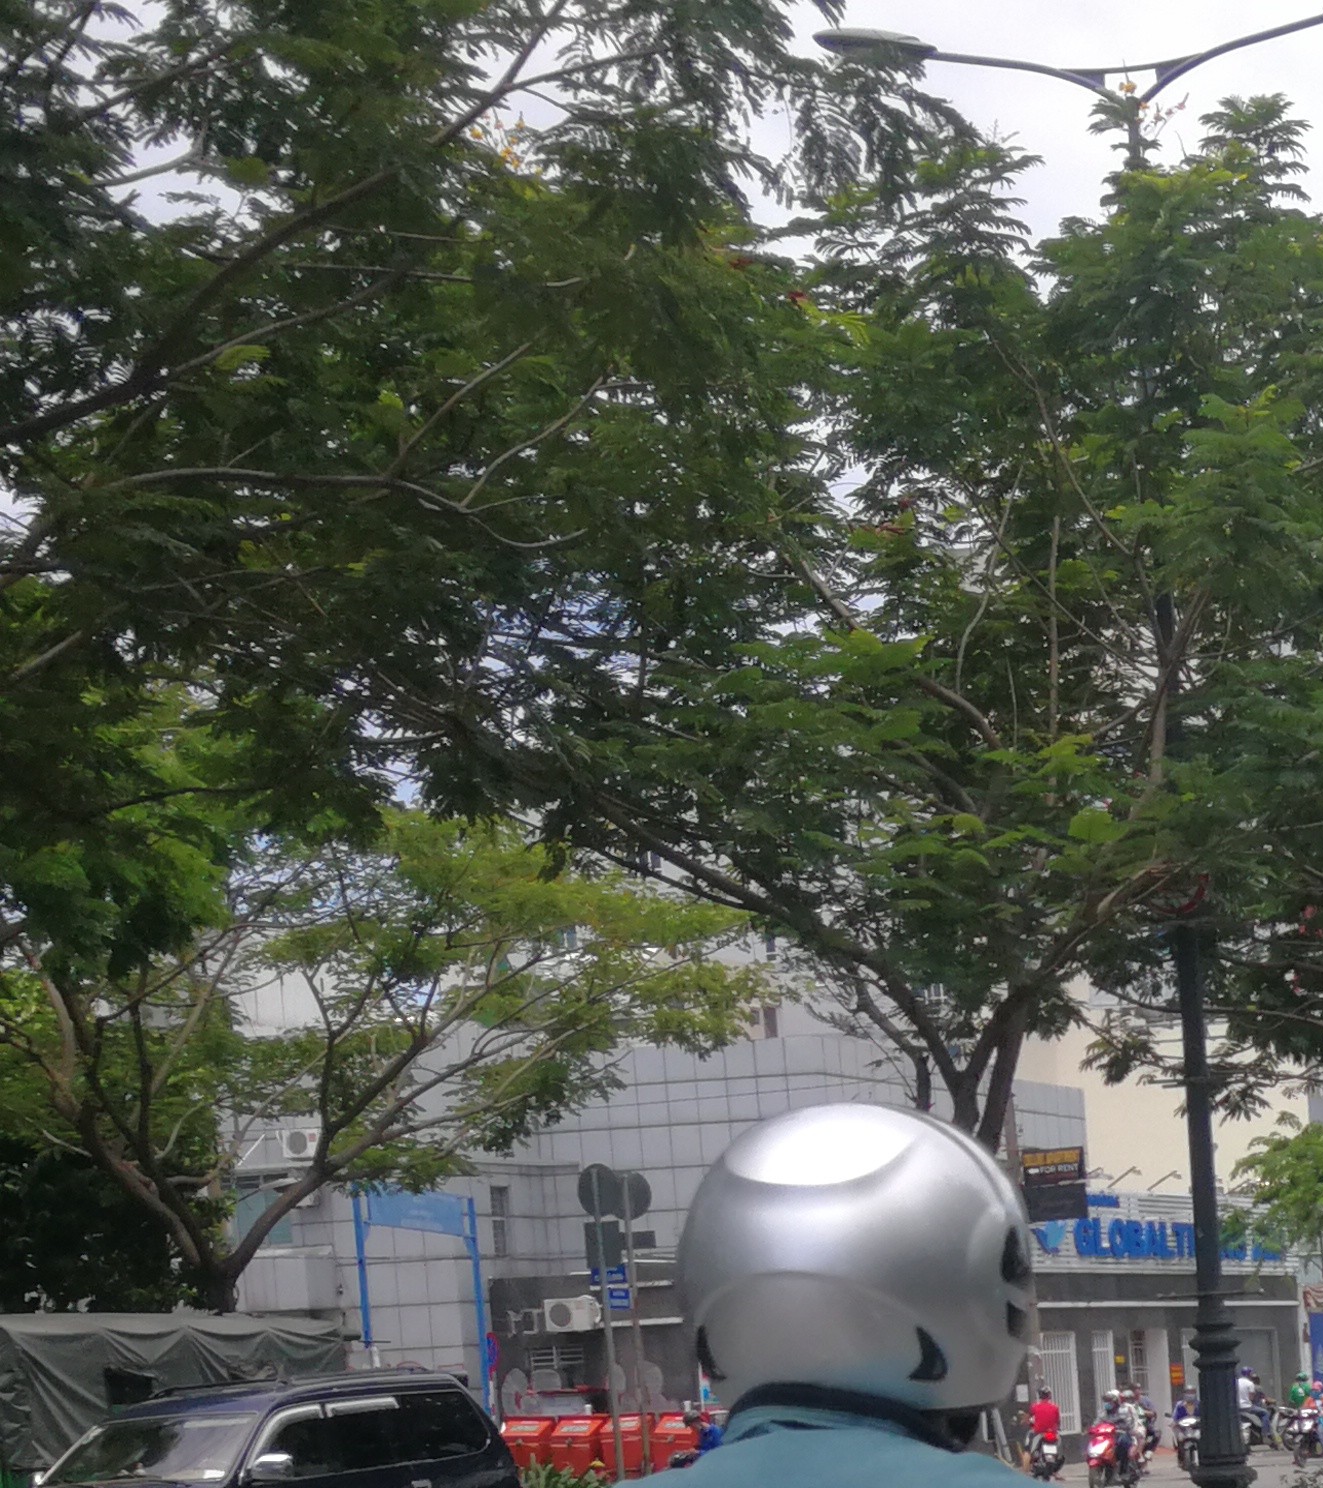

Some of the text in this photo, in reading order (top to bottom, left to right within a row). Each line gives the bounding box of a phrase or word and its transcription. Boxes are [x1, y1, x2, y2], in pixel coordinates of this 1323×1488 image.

[1040, 1164, 1079, 1174] FOR RENT
[1074, 1218, 1176, 1259] GLOBAL
